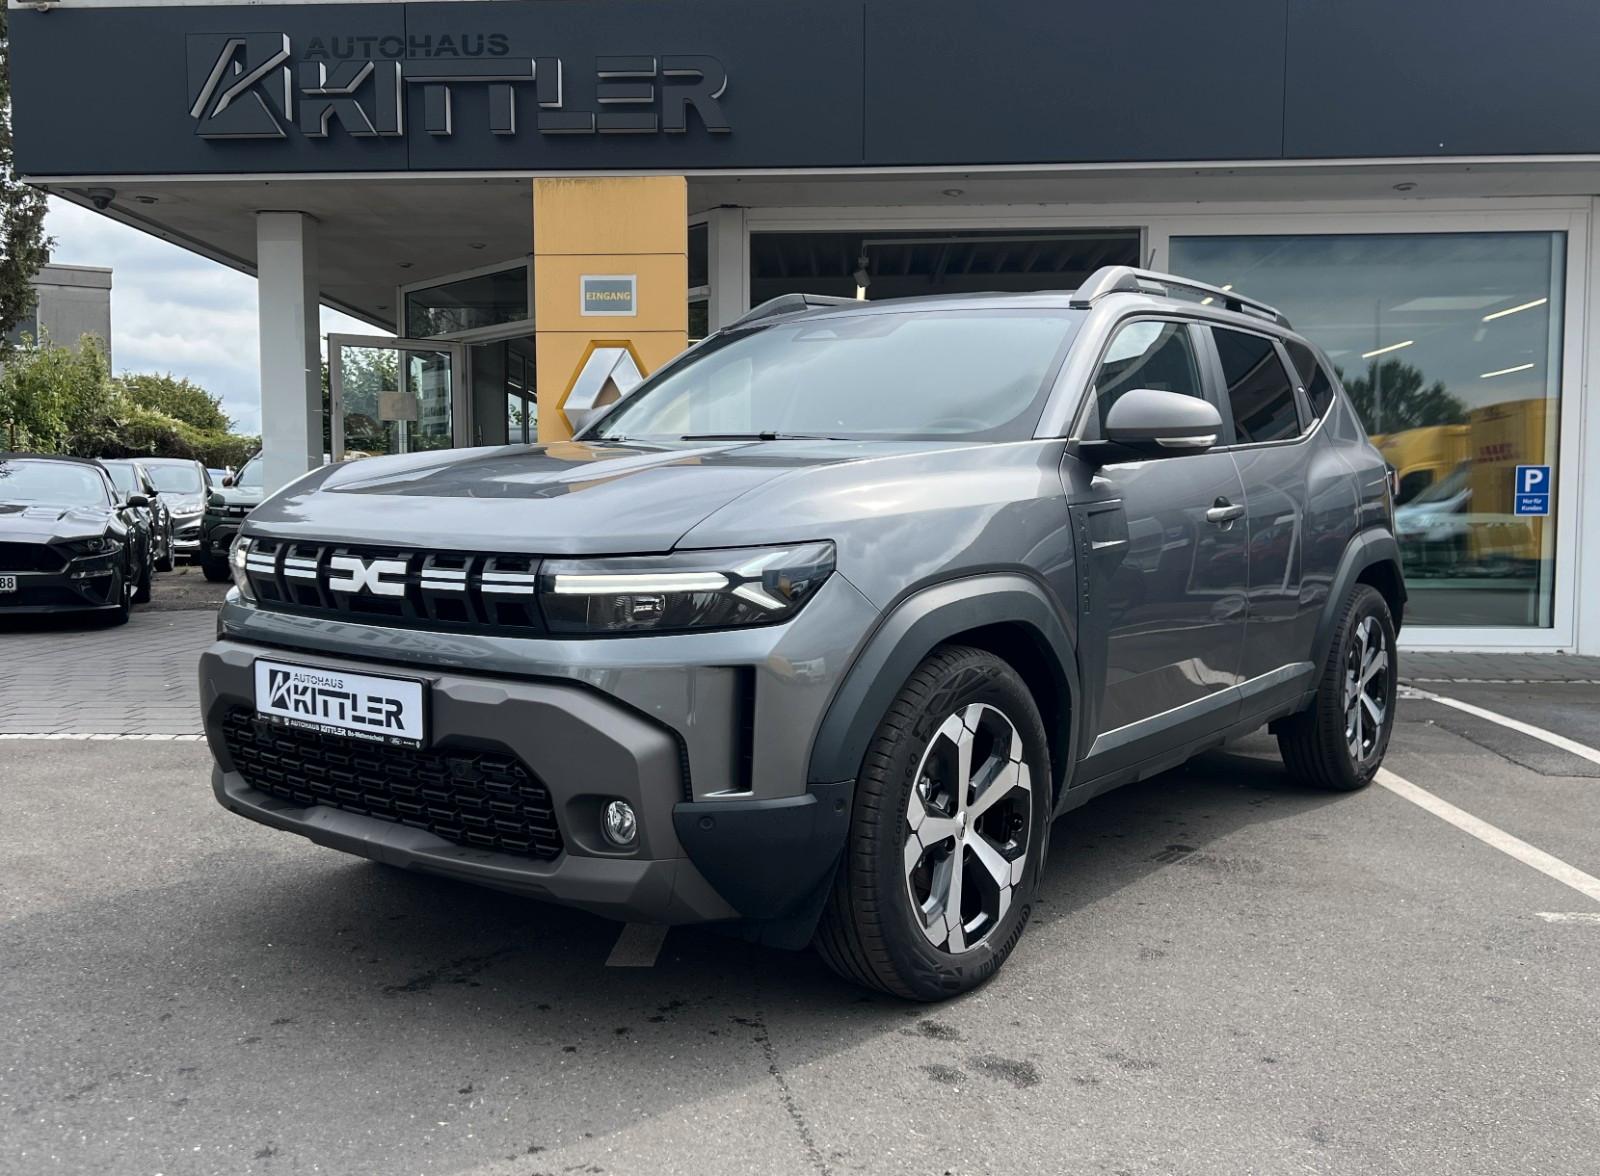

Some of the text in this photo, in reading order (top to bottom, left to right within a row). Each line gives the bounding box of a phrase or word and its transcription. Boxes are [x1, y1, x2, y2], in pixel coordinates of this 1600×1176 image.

[303, 33, 510, 59] AUTOHAUS
[299, 55, 732, 137] KITTLER
[586, 291, 631, 301] EINGANG
[1525, 469, 1543, 492] P
[293, 672, 344, 690] AUTOHAUS
[293, 685, 405, 731] KITTLER
[290, 719, 320, 731] AUTOHAUS
[320, 724, 346, 737] KITTLER
